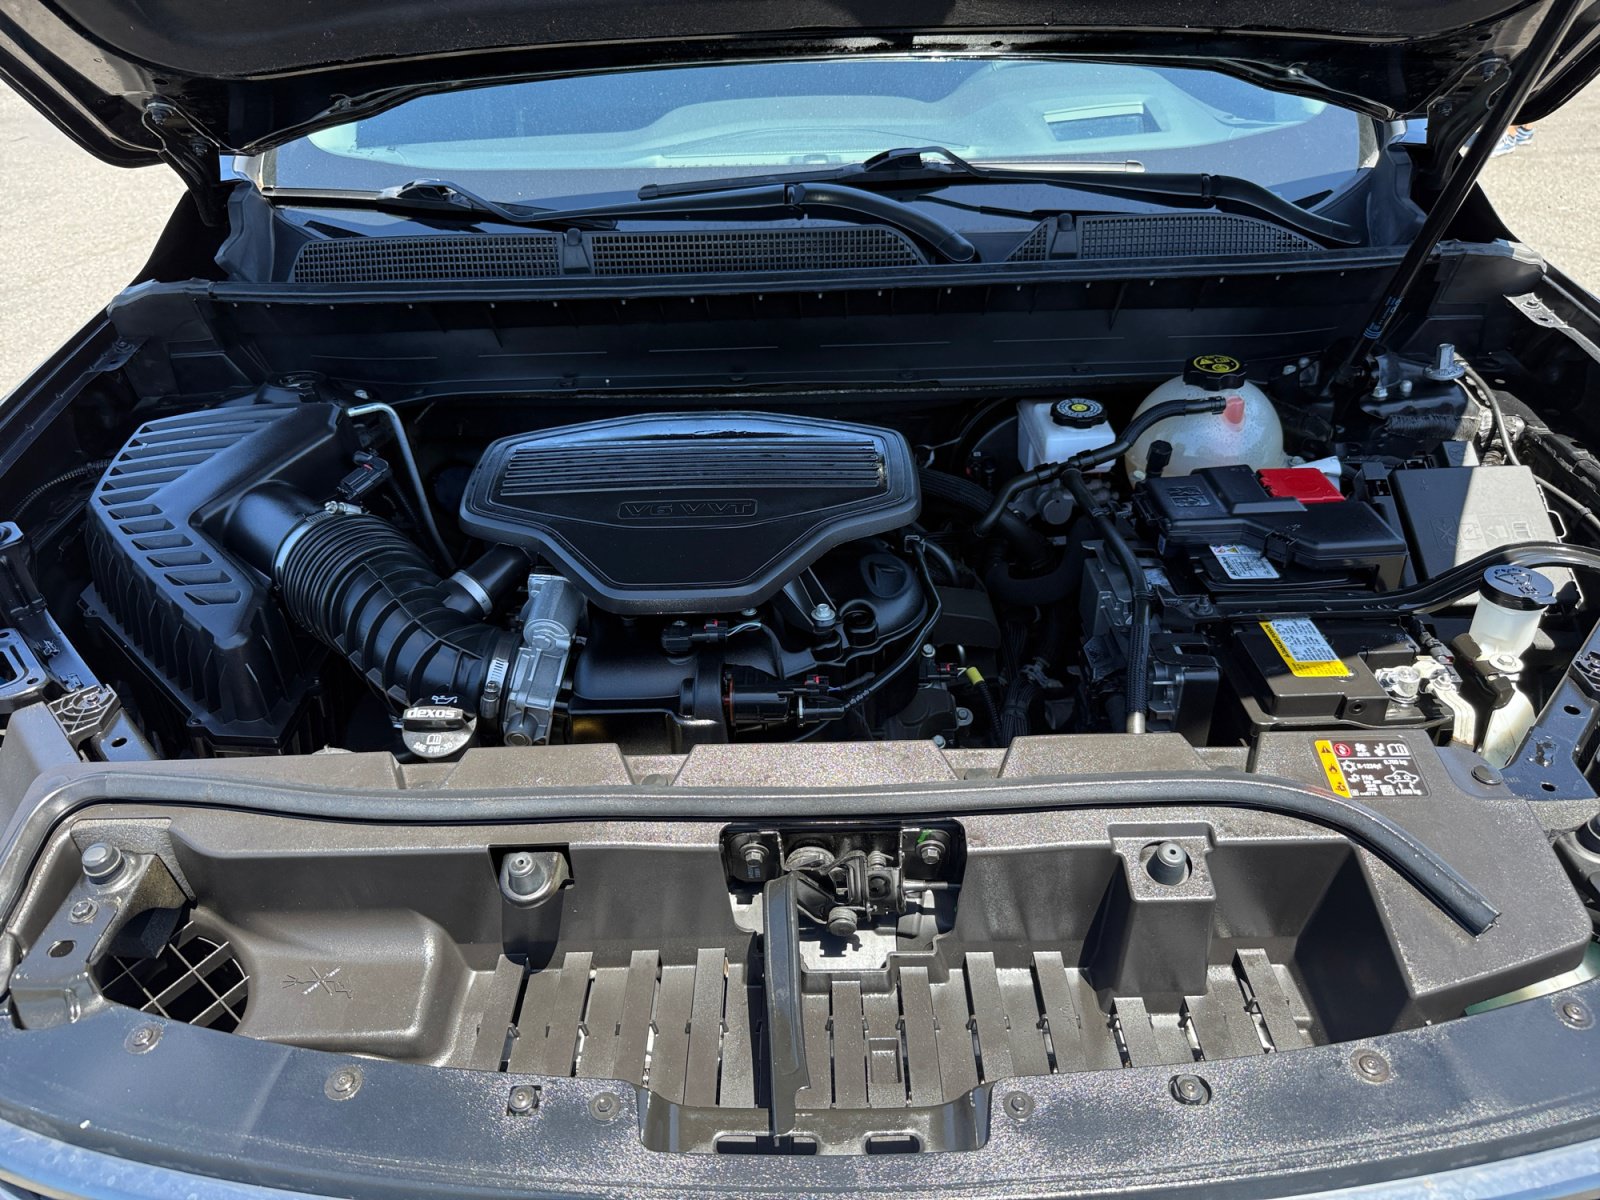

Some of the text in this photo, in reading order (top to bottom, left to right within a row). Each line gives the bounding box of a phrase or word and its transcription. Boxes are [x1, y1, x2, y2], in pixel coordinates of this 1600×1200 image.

[625, 503, 751, 516] V6 VVT
[406, 707, 457, 718] dexos
[413, 742, 453, 753] SAE 5W-30
